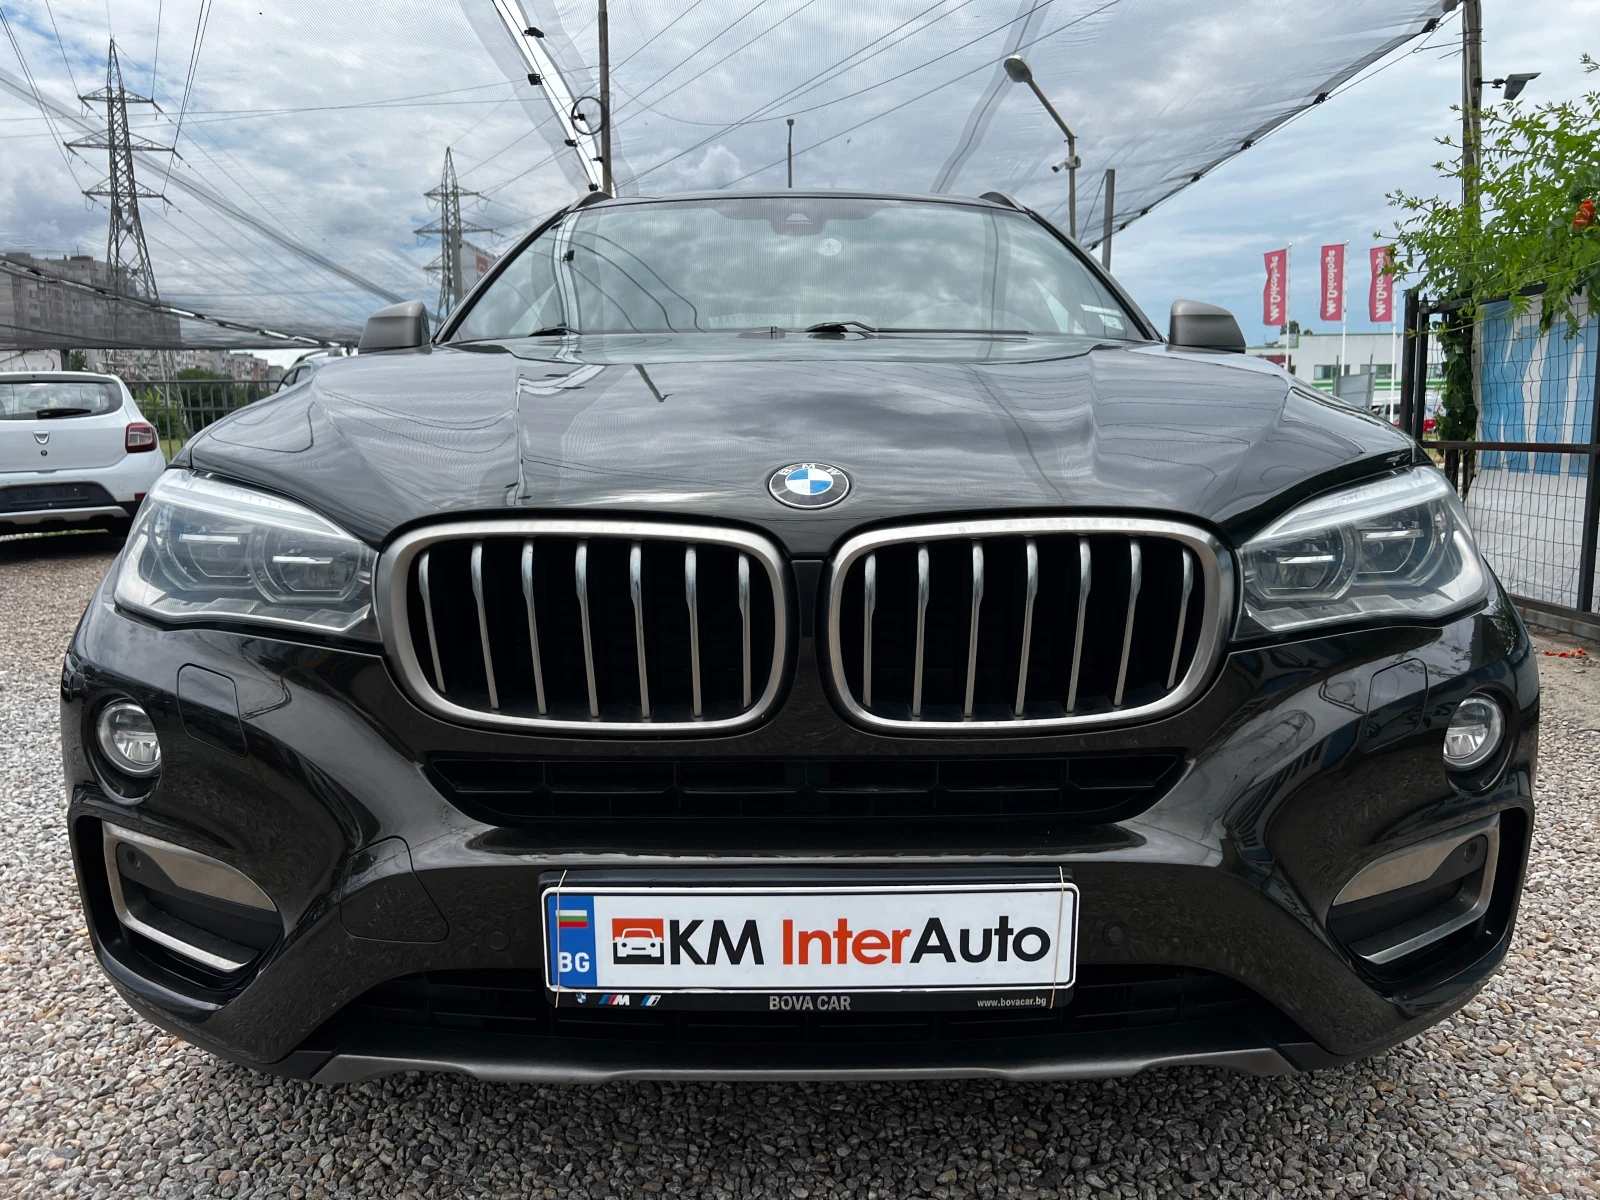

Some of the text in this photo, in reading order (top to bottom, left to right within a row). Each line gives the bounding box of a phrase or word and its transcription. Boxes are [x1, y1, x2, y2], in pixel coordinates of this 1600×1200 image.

[778, 463, 841, 476] BMW
[669, 915, 1051, 965] KM InterAuto
[558, 952, 590, 973] BG
[769, 995, 851, 1011] BOVA CAR
[977, 996, 1047, 1008] www.bovacar.bg
